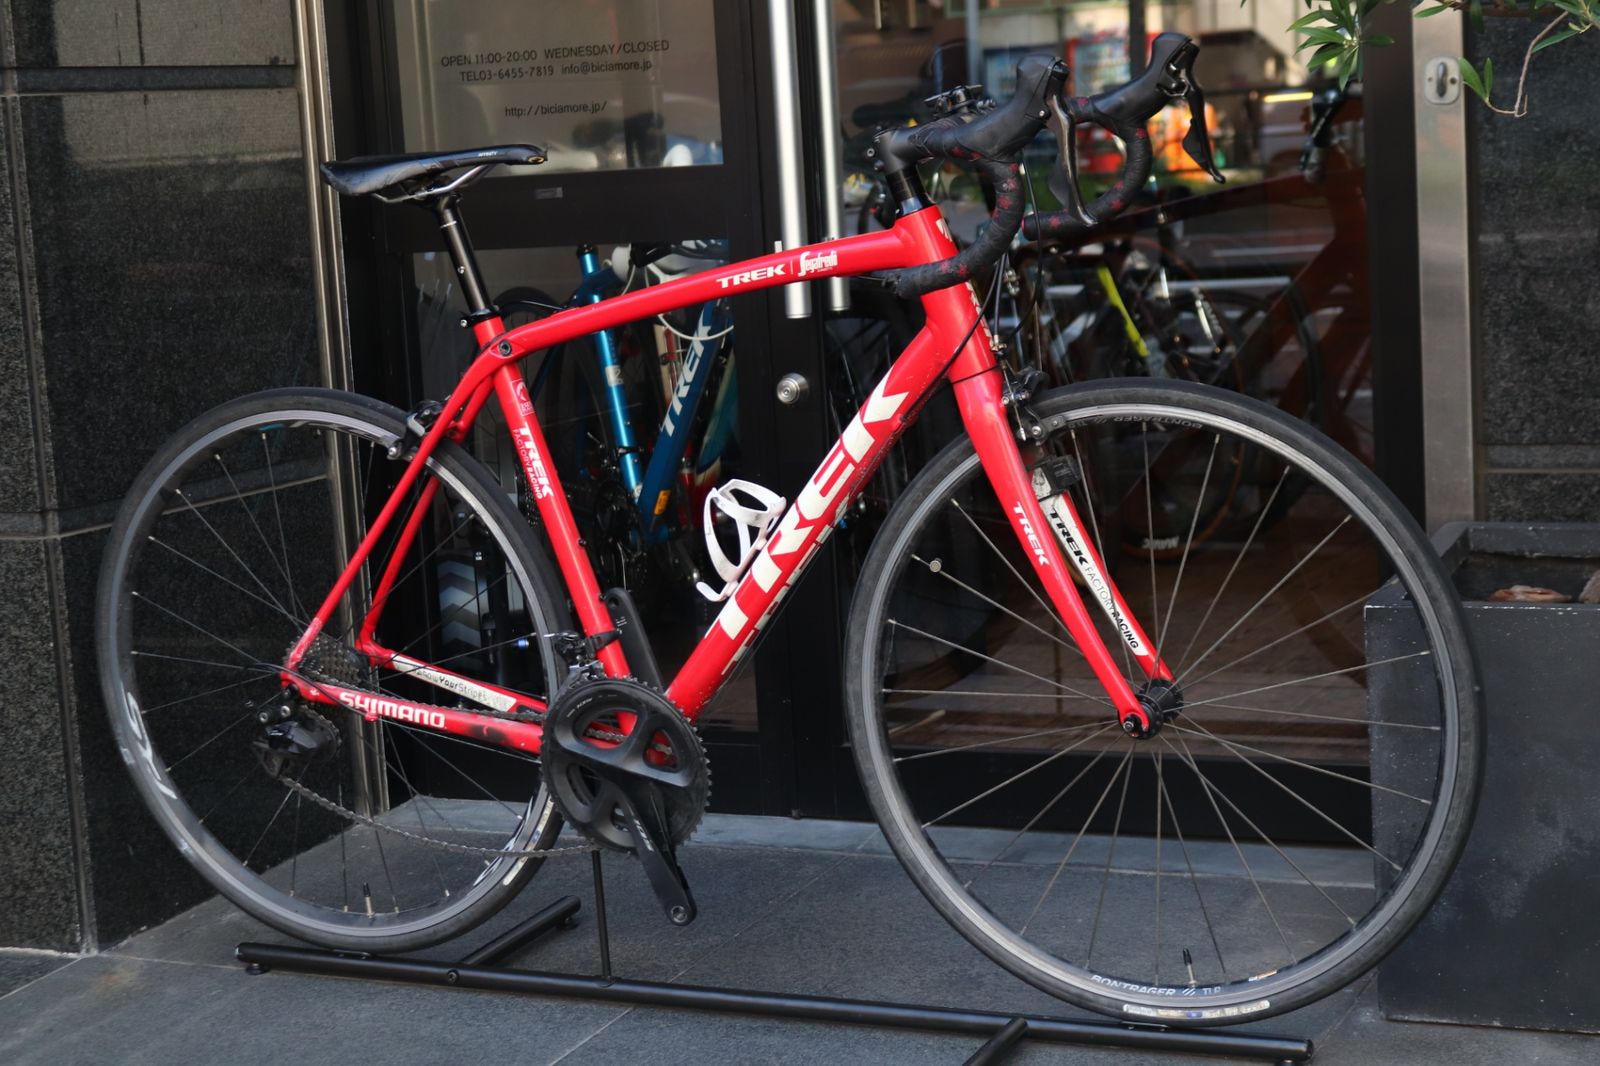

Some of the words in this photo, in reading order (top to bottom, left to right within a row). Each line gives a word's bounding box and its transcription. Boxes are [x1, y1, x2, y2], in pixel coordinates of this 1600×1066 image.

[441, 55, 472, 67] OPEN
[475, 49, 538, 64] 11:00-20:00
[544, 40, 670, 59] WEDNESDAY/CLOSED
[561, 59, 652, 75] info@biciamore.jp
[504, 101, 607, 118] http://biciamore.jp/
[716, 263, 786, 289] TREK
[659, 304, 712, 437] TREK
[519, 421, 554, 497] TREK
[703, 364, 910, 641] TREK
[1013, 501, 1050, 566] TREK
[1050, 507, 1088, 565] TREK
[338, 691, 446, 729] SHIMANO
[1090, 974, 1177, 997] BONTRAGER
